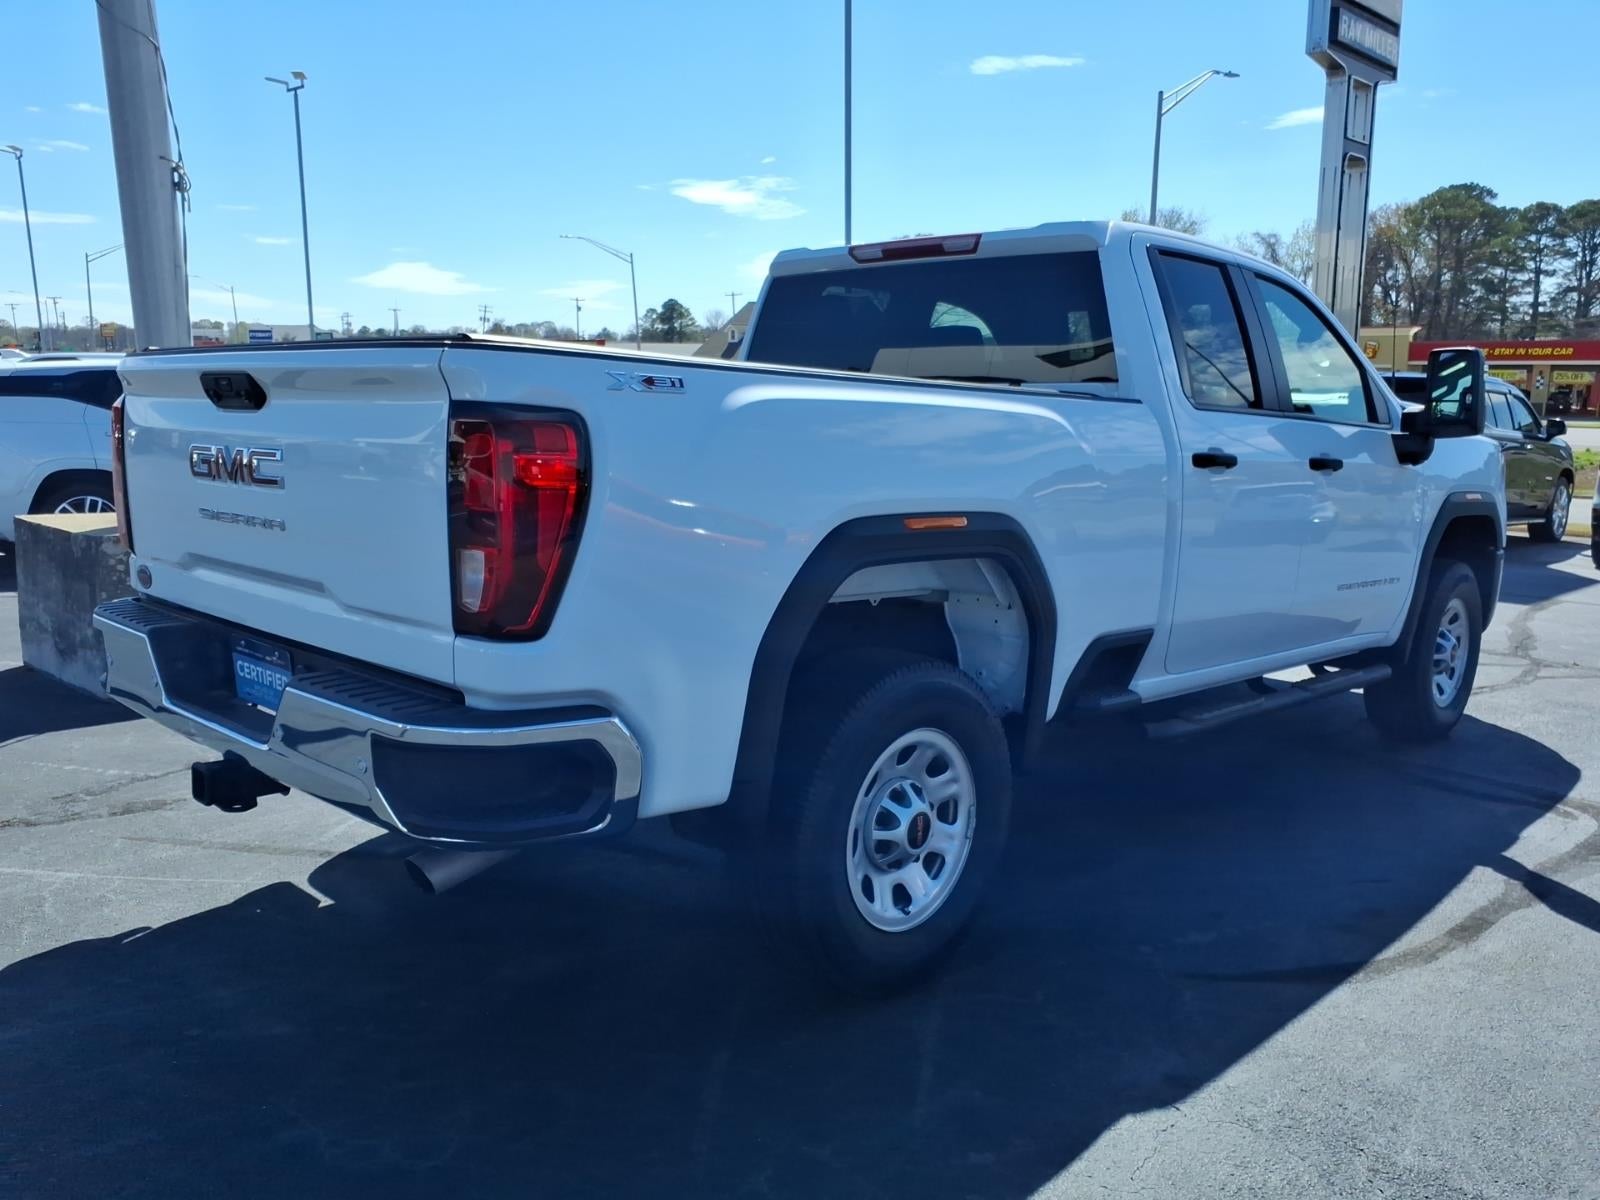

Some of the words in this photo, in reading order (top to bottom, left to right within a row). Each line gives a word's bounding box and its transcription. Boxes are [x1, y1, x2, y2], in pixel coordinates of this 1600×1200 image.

[1341, 15, 1362, 43] RAY
[1571, 373, 1585, 381] OFF
[189, 444, 286, 490] GMC
[199, 507, 286, 532] SIERRA
